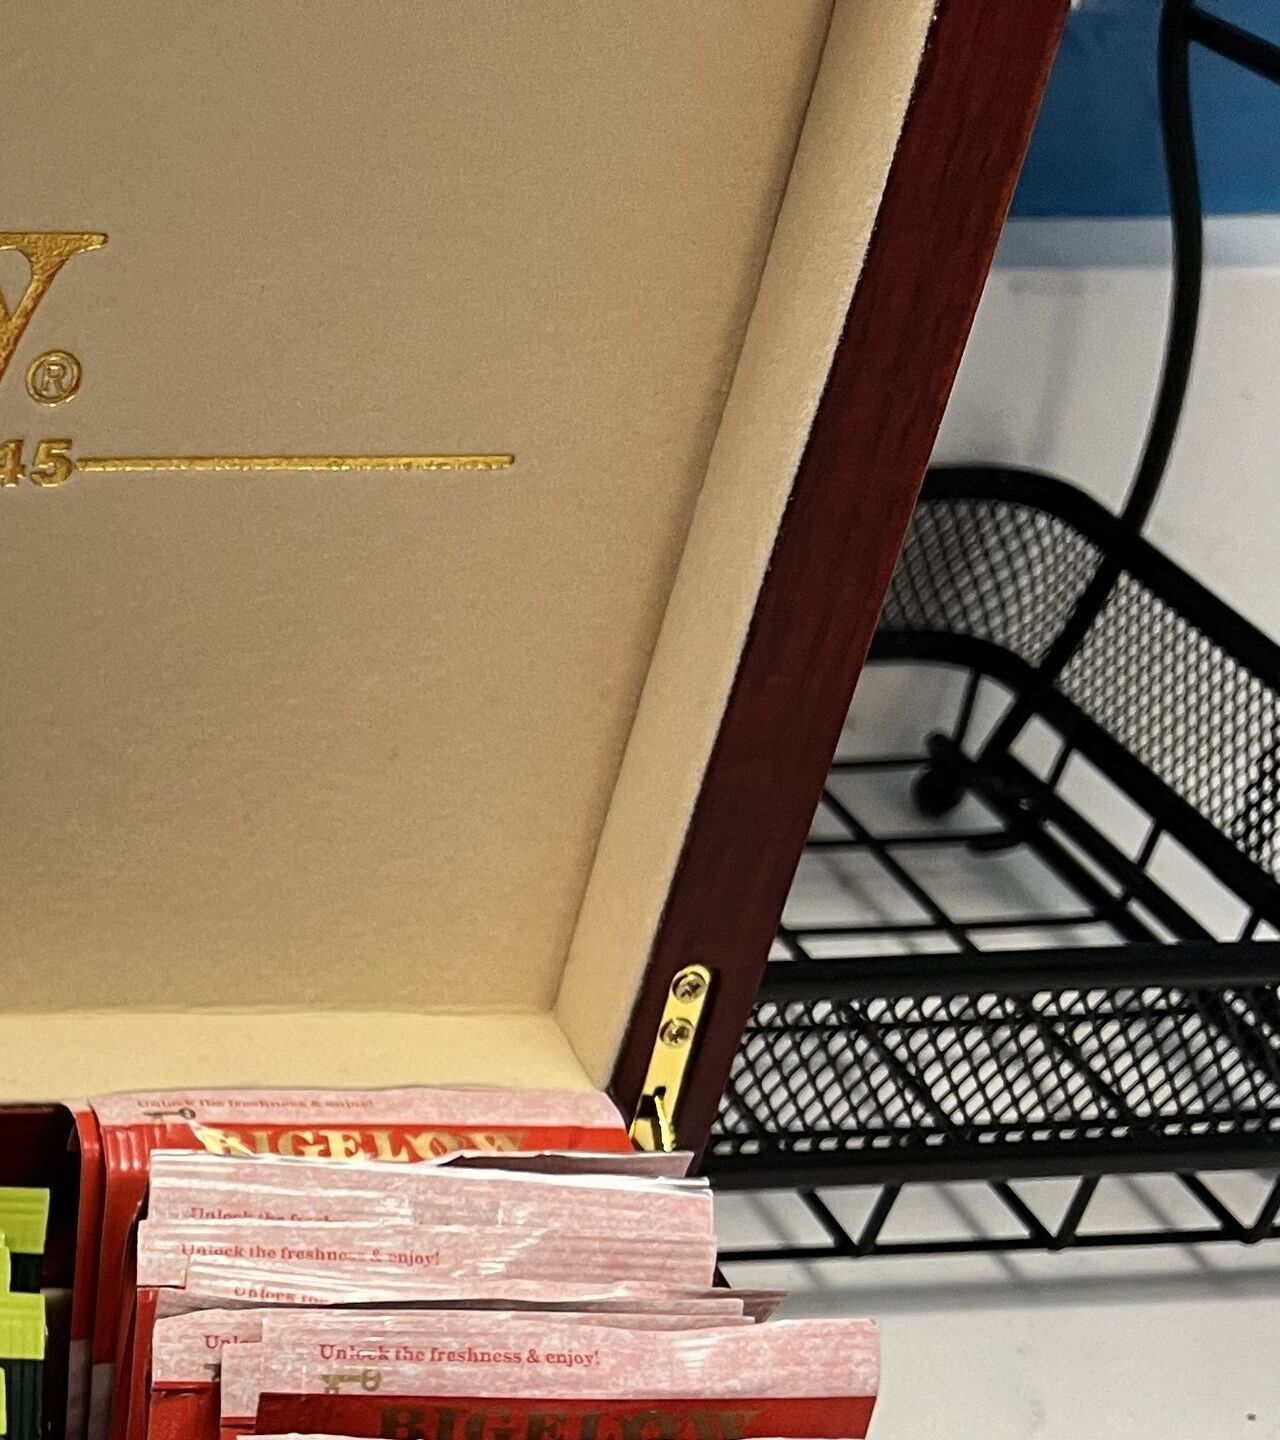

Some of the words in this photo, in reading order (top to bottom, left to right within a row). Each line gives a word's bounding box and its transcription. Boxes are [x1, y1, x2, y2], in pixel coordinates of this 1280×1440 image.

[249, 1246, 276, 1259] the
[396, 1346, 424, 1361] the
[430, 1347, 521, 1363] freshness
[526, 1349, 542, 1363] &
[546, 1350, 599, 1367] enjoy!
